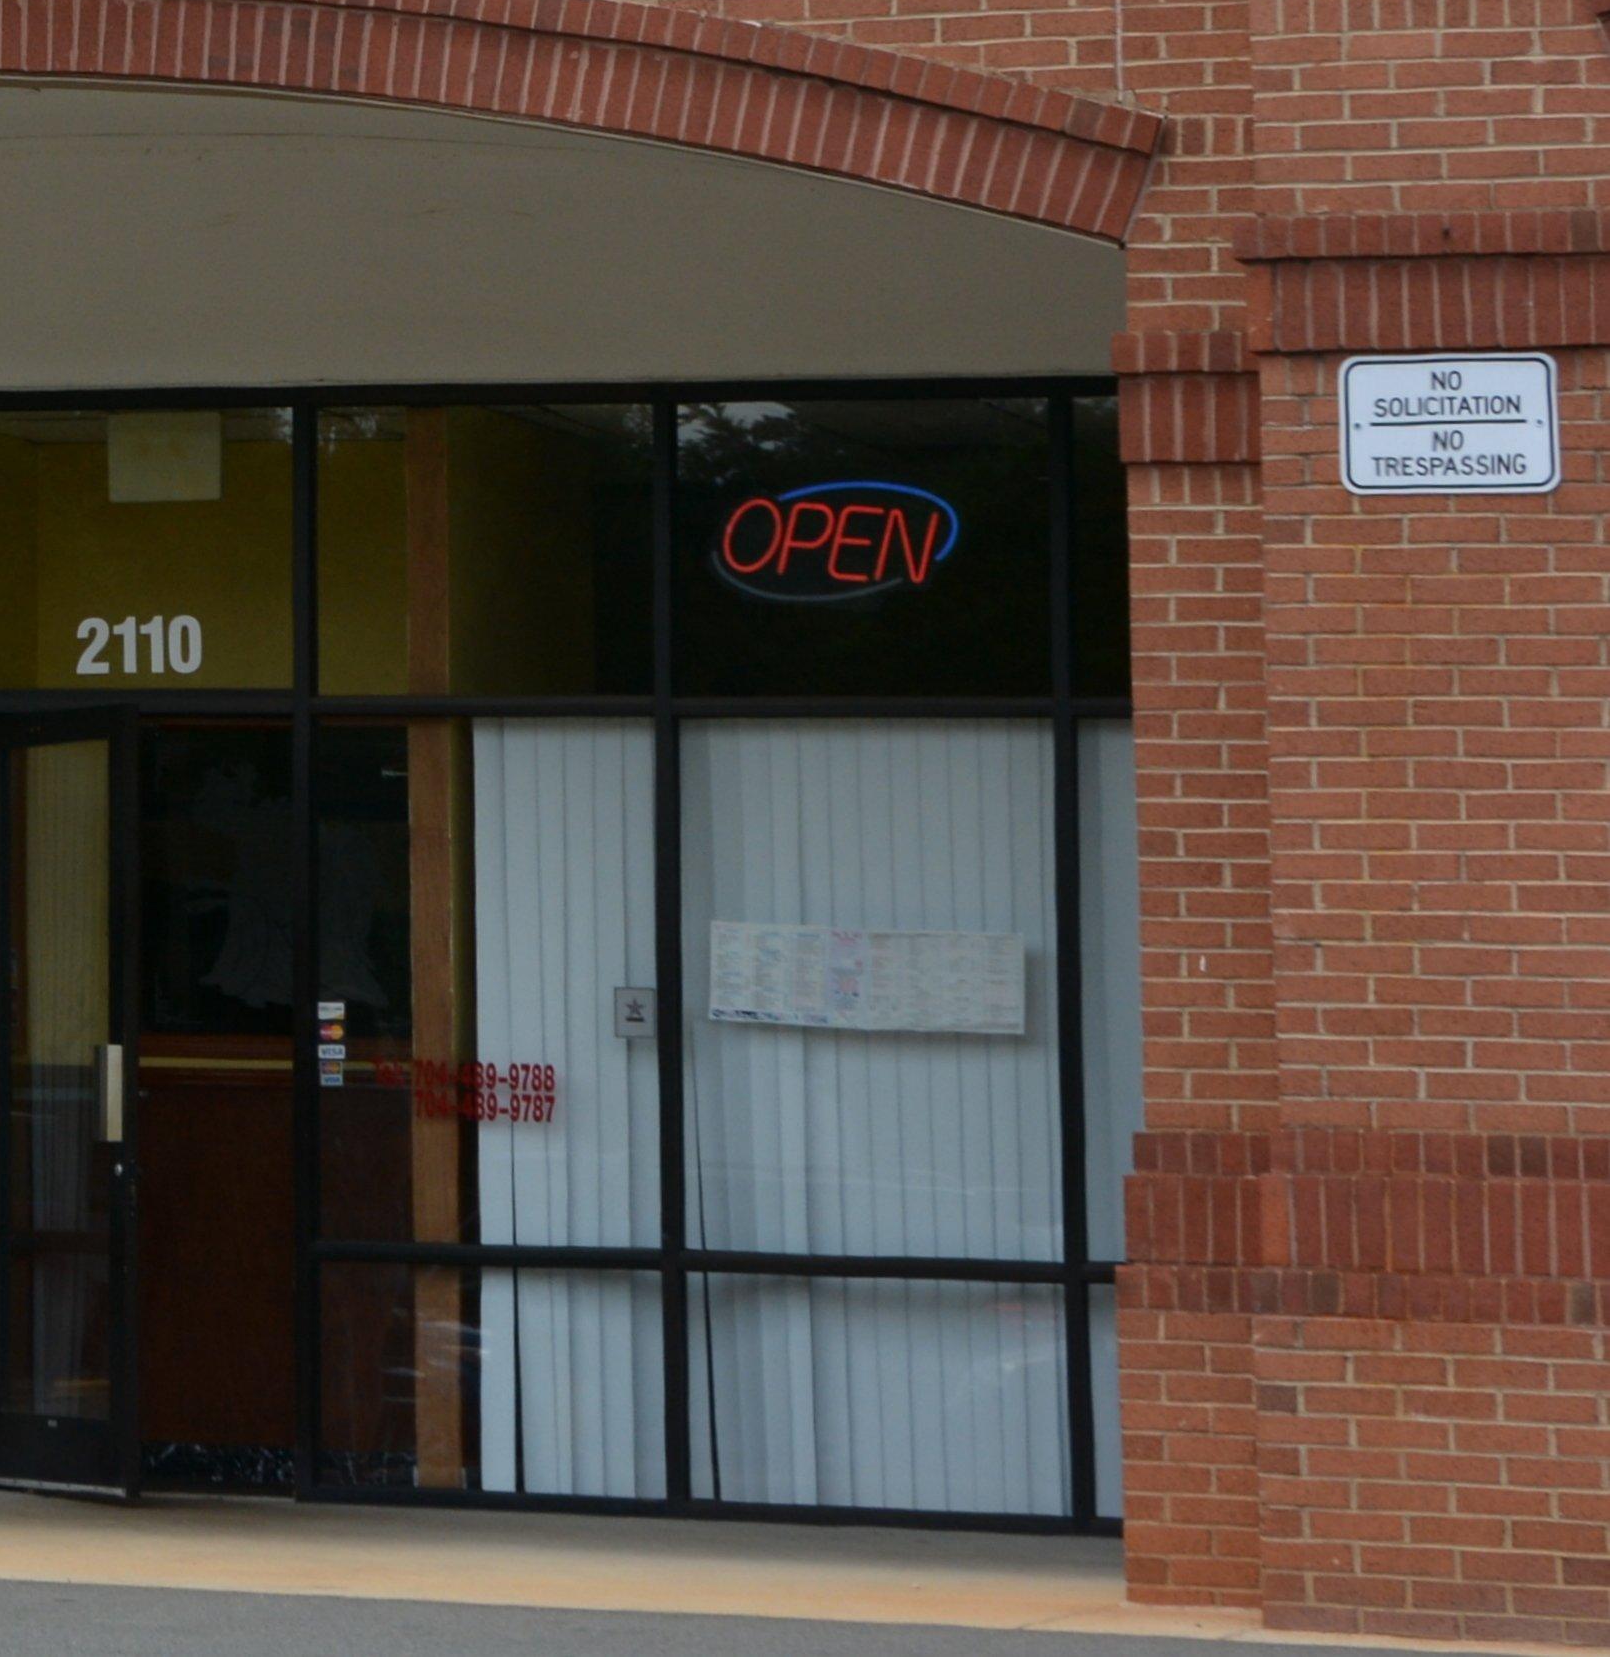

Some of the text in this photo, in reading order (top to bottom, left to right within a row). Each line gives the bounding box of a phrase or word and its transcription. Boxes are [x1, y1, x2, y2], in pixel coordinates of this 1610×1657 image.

[1430, 370, 1462, 391] NO
[1373, 395, 1522, 417] SOLICITATION
[1432, 430, 1464, 452] NO
[1371, 453, 1526, 477] TRESPASSING
[722, 497, 940, 585] OPEN
[75, 614, 203, 675] 2110
